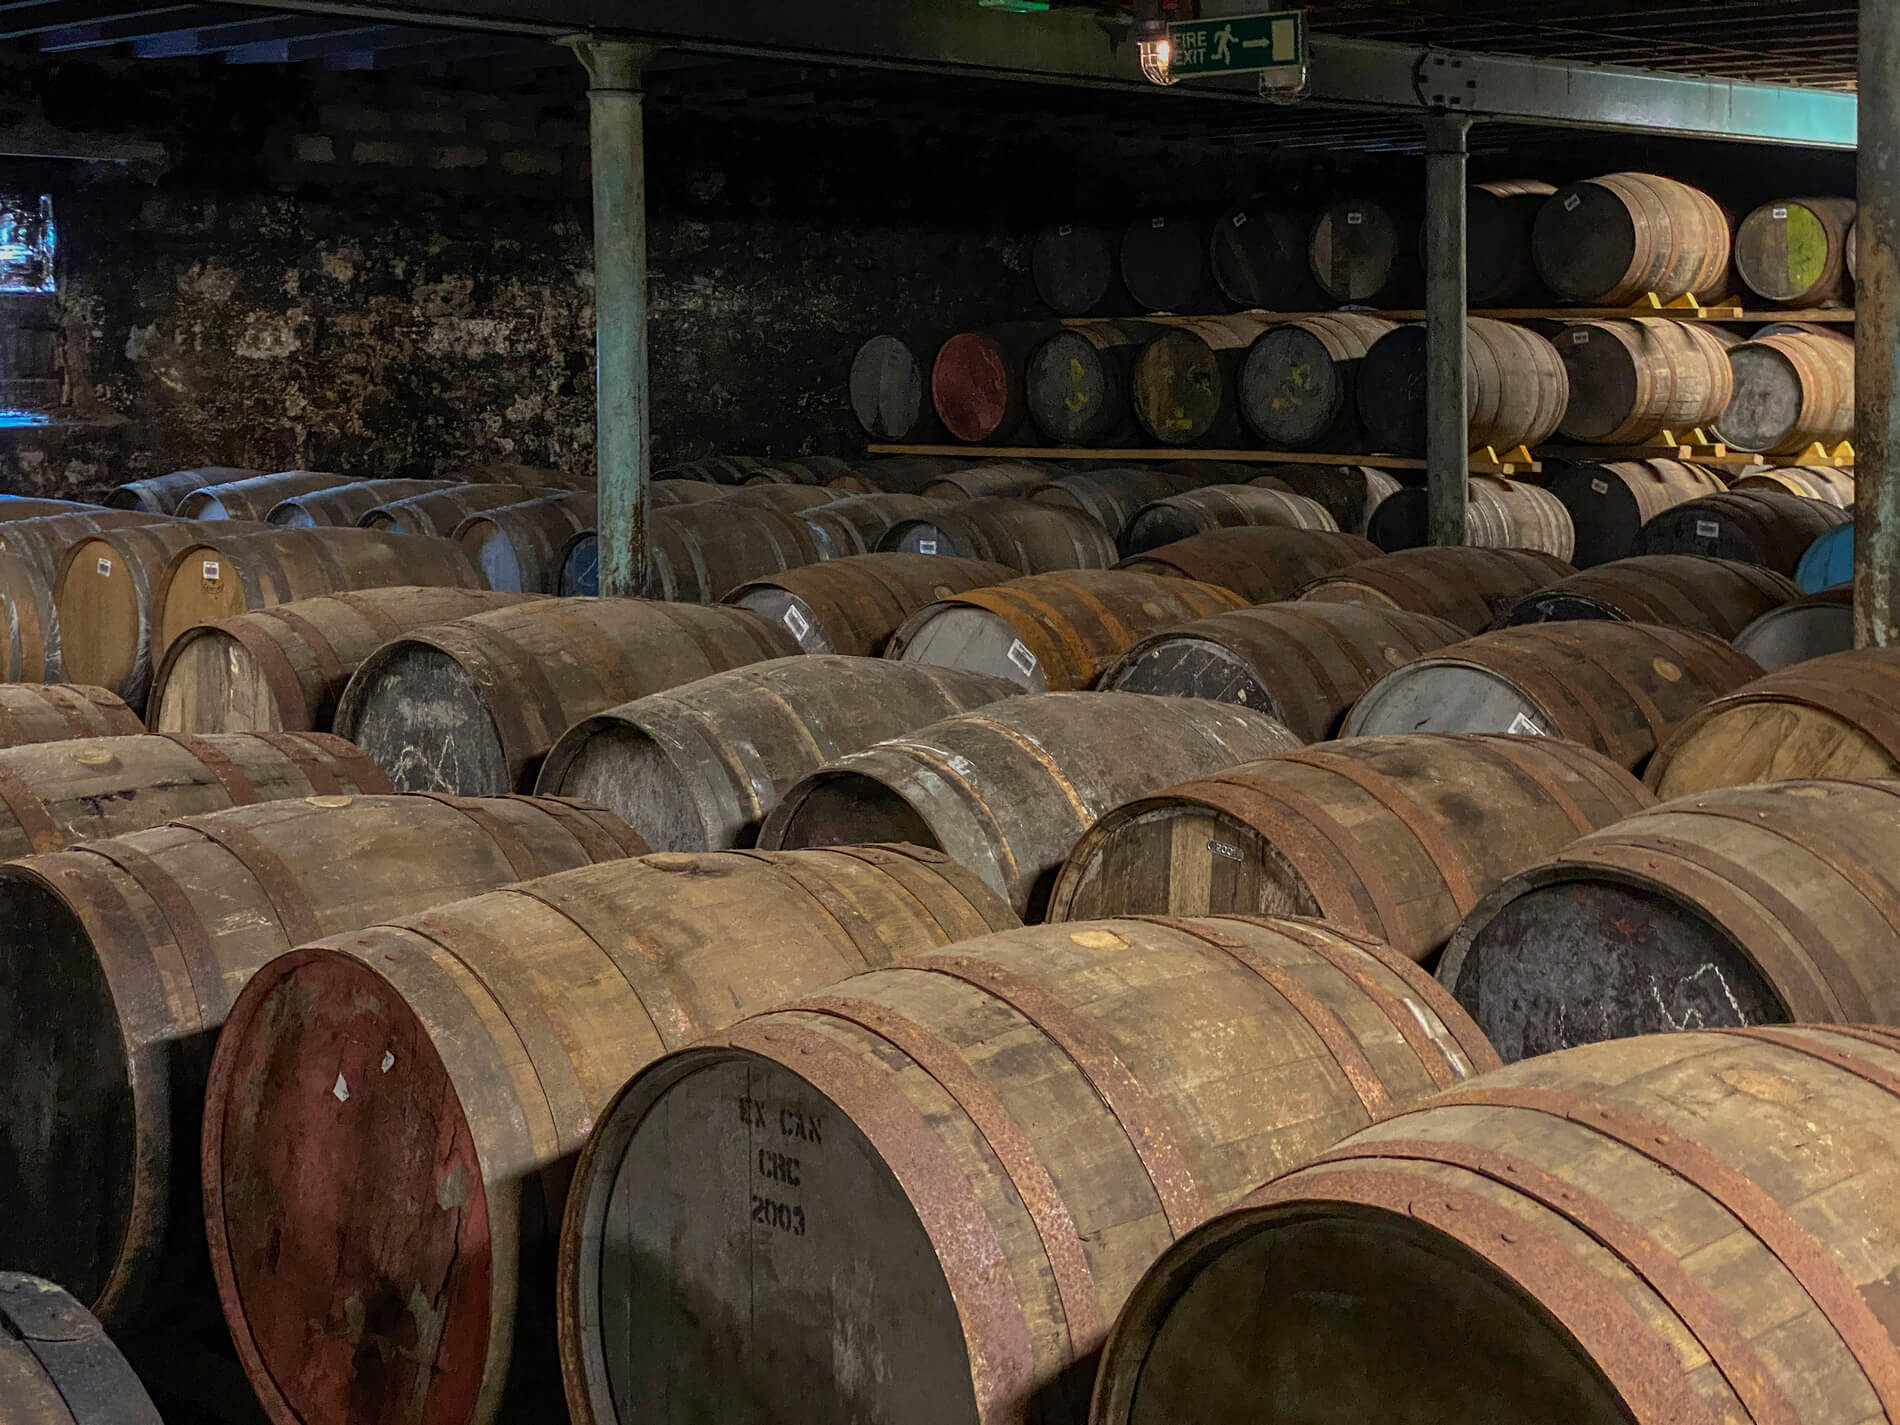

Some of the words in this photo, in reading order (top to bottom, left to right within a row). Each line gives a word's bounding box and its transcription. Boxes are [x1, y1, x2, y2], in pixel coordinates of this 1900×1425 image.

[1173, 31, 1207, 49] FIRE
[1173, 48, 1207, 66] EXIT
[739, 1096, 766, 1128] EX
[780, 1108, 822, 1145] CAN
[751, 1194, 805, 1237] 2003
